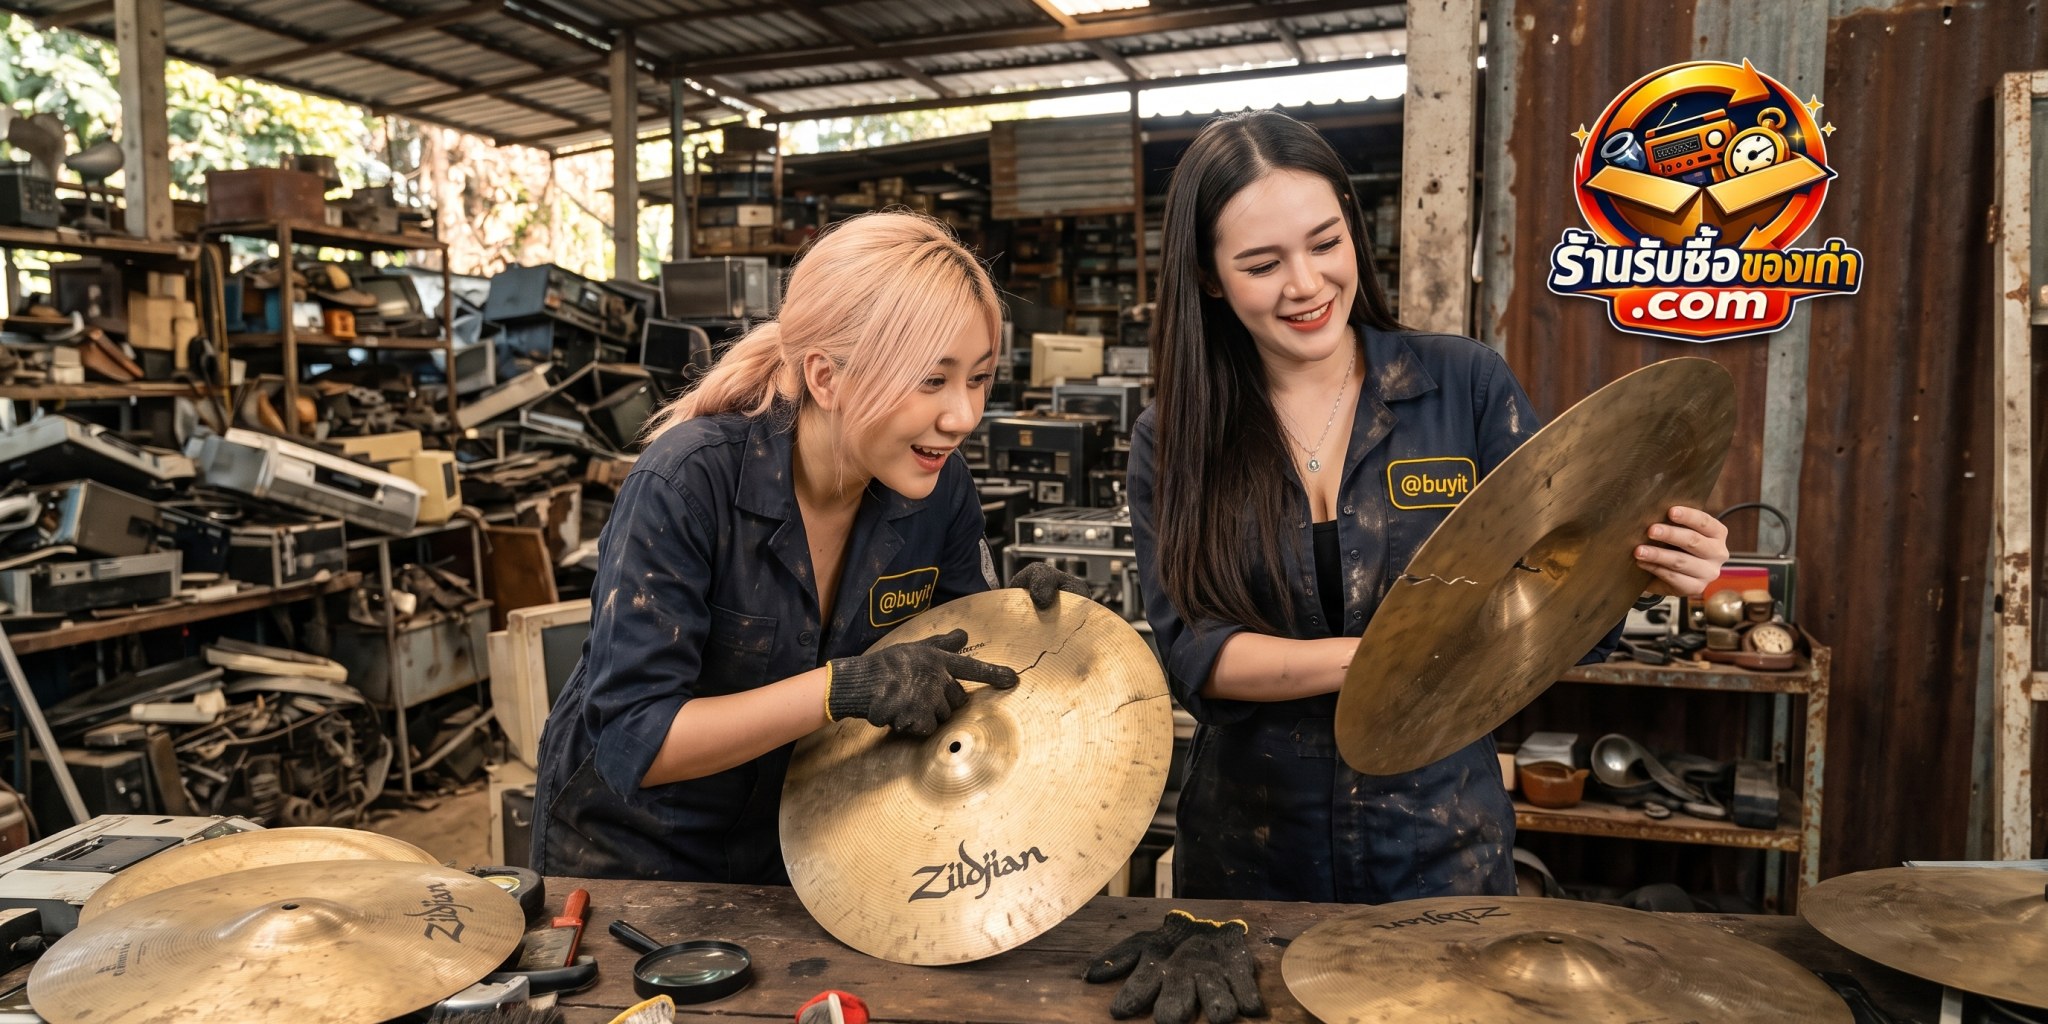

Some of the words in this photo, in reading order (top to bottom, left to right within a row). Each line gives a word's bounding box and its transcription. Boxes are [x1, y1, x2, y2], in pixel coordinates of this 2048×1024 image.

[1401, 473, 1468, 497] @buyit
[880, 583, 932, 614] @buyit
[908, 839, 1049, 904] Zildjian
[403, 882, 474, 944] Zildjian
